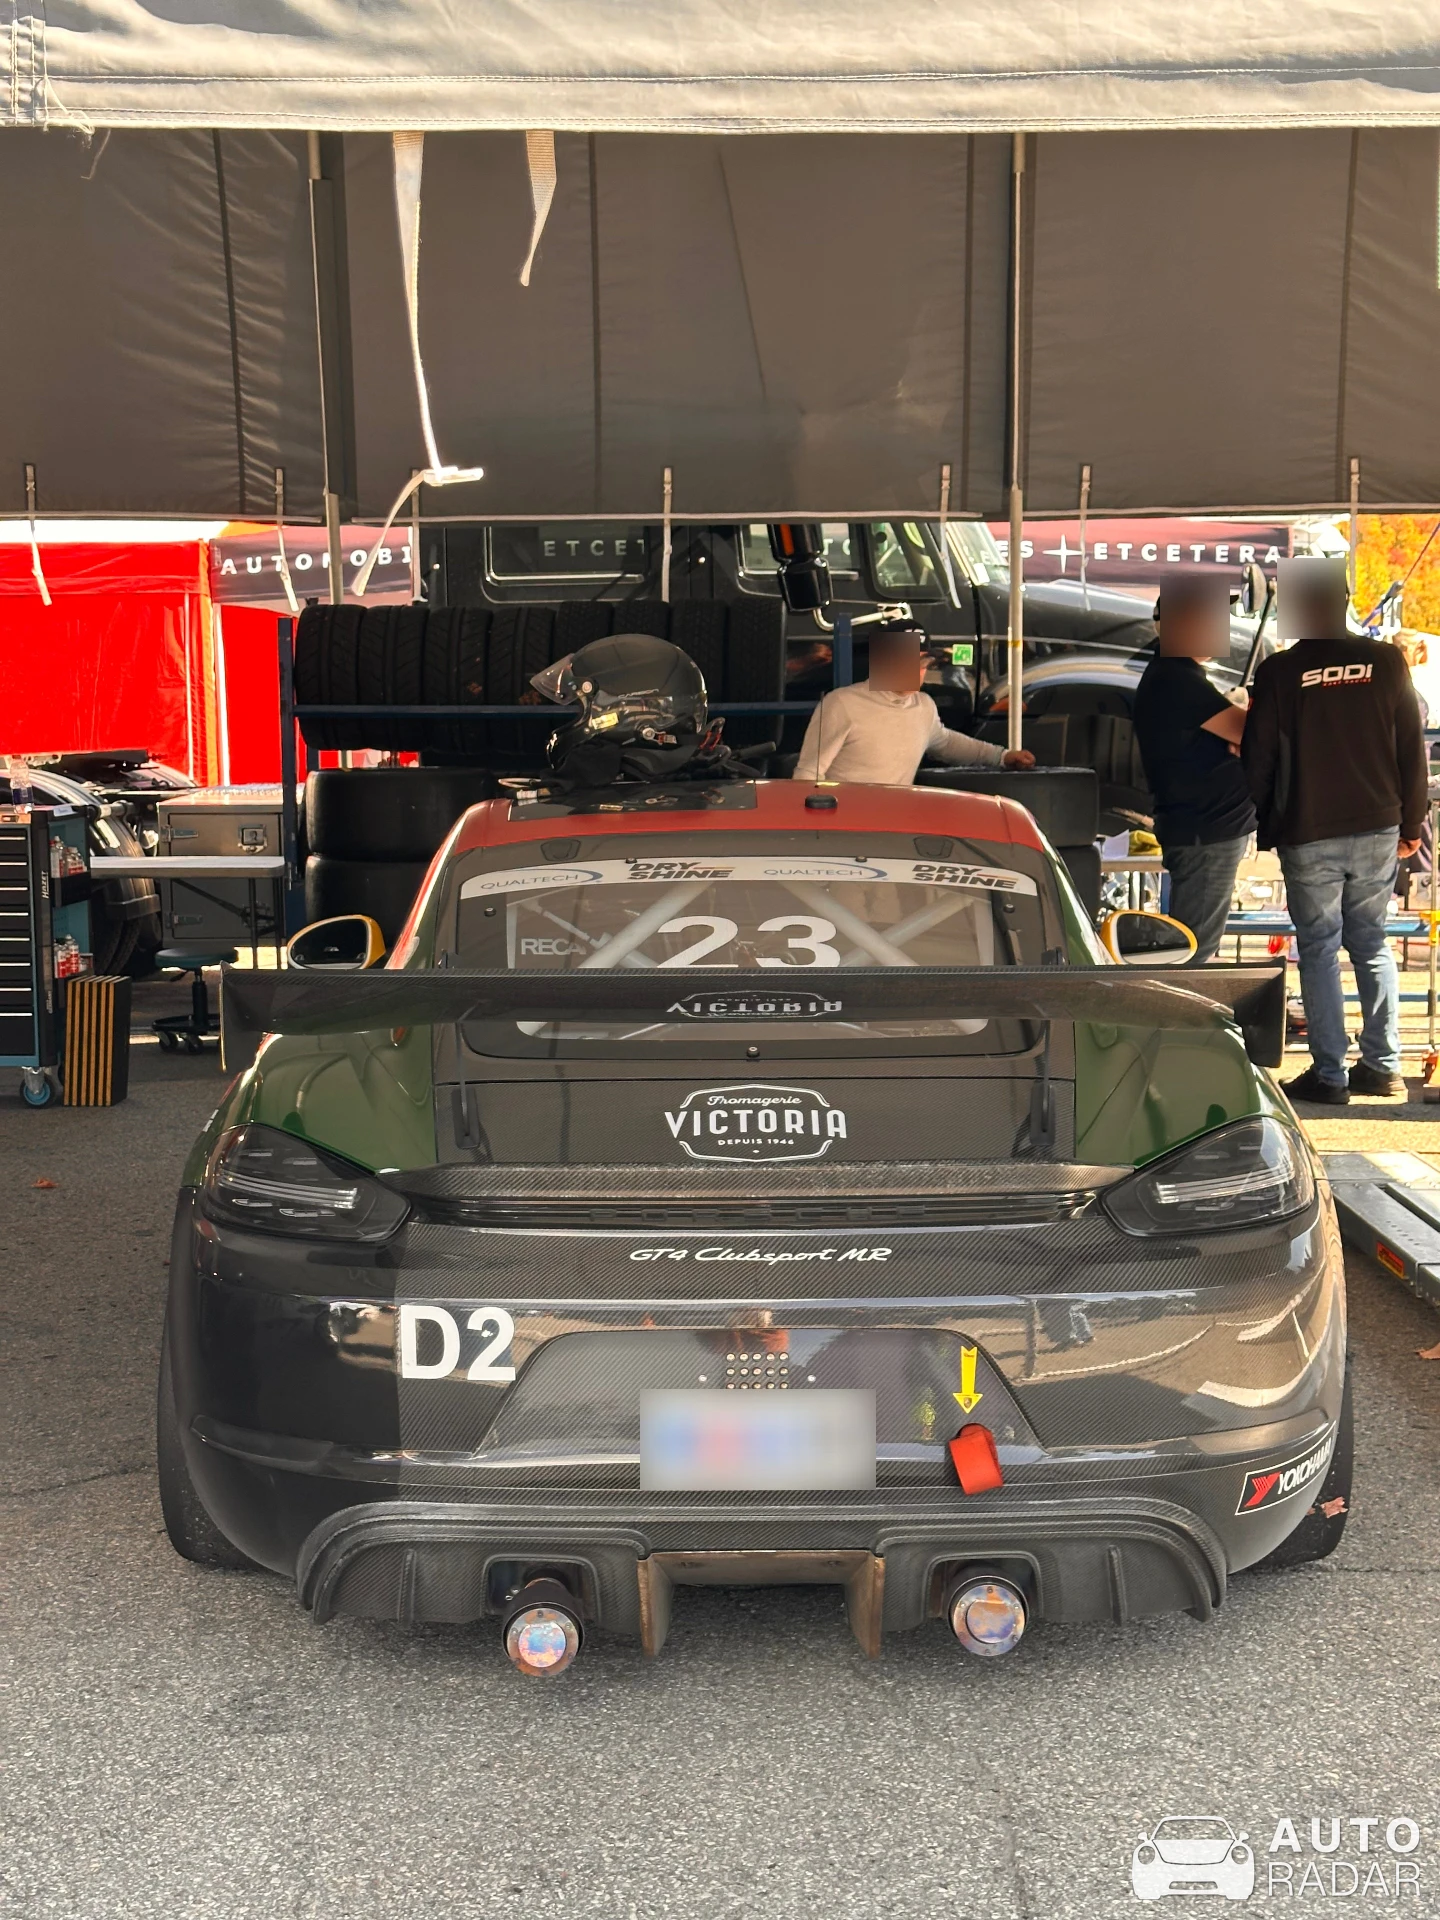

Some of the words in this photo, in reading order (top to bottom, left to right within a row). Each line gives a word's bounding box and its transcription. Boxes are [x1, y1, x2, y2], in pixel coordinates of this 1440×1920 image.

[1093, 542, 1282, 564] ETCETERA
[1301, 664, 1373, 688] SODI
[627, 869, 734, 880] SHINE
[629, 861, 702, 871] DRY
[912, 864, 982, 875] DRY
[480, 874, 579, 890] QUALTECH
[912, 872, 1017, 889] SHINE
[707, 1096, 802, 1107] Fromagerie
[664, 1109, 847, 1138] VICTORIA
[717, 1138, 763, 1146] DEPUIS
[629, 1248, 689, 1261] GT4
[694, 1247, 838, 1265] Clubsport
[837, 1248, 892, 1261] MR
[400, 1304, 516, 1381] D2
[1277, 1437, 1332, 1495] YOKOHAMA
